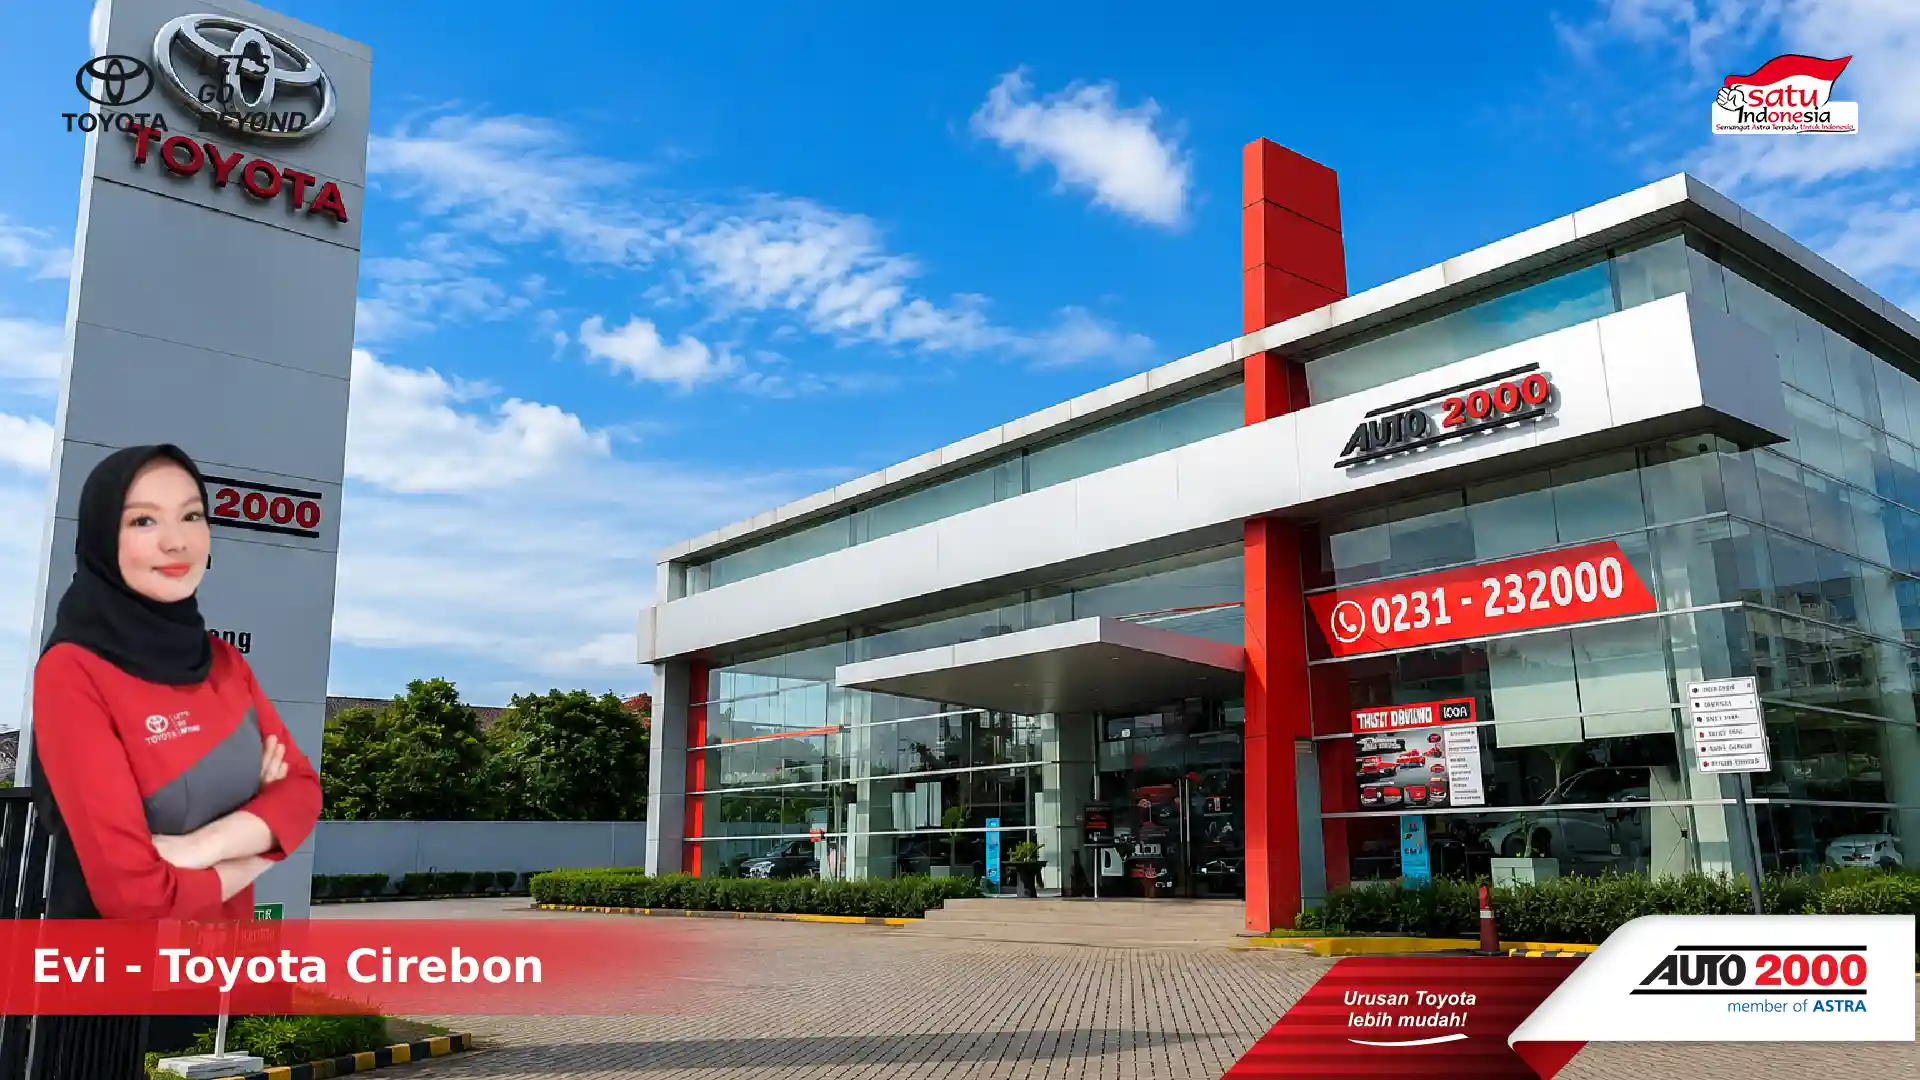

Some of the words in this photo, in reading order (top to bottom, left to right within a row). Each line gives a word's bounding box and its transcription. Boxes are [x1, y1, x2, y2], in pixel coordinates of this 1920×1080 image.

[126, 121, 347, 223] TOYOTA
[1339, 408, 1427, 458] AUTO
[1441, 373, 1550, 429] 2000
[213, 487, 321, 529] 2000
[1371, 587, 1452, 634] 0231
[1481, 557, 1623, 619] 232000
